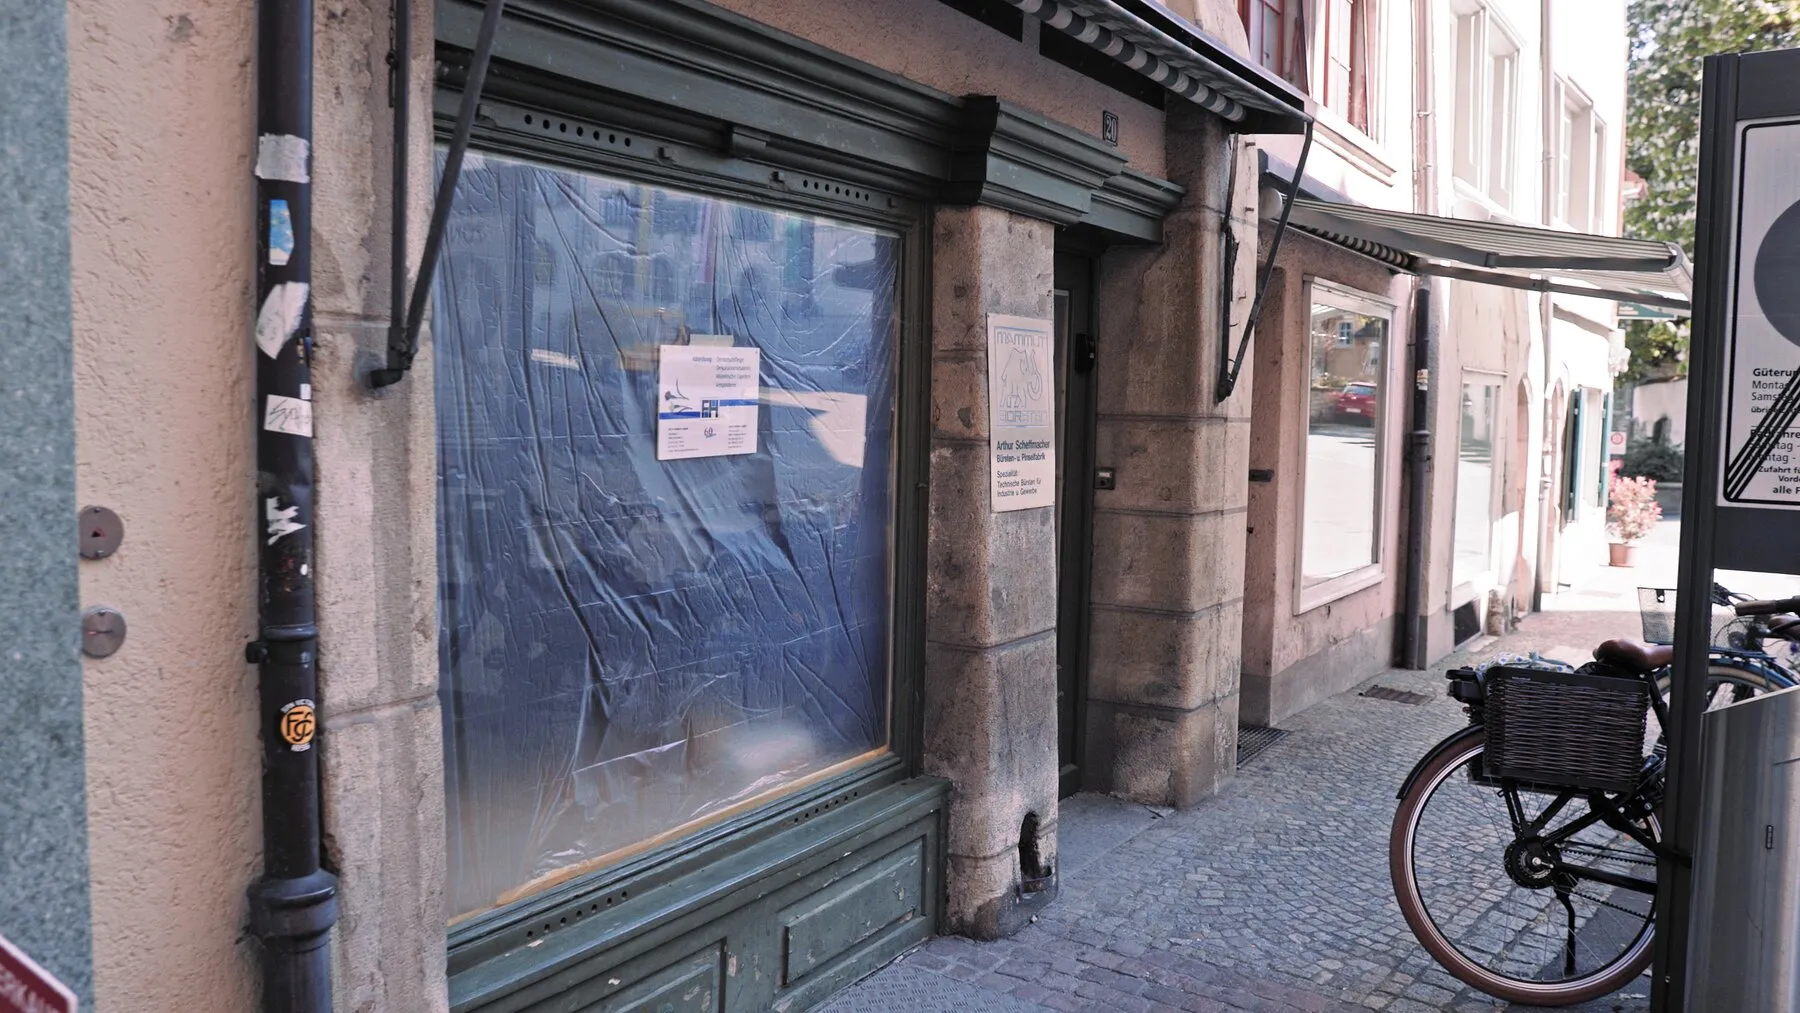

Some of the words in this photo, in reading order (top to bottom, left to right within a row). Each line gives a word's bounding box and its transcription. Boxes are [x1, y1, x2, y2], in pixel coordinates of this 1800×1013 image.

[1105, 115, 1117, 142] 20
[997, 440, 1014, 451] Arthur
[1773, 485, 1792, 494] alle
